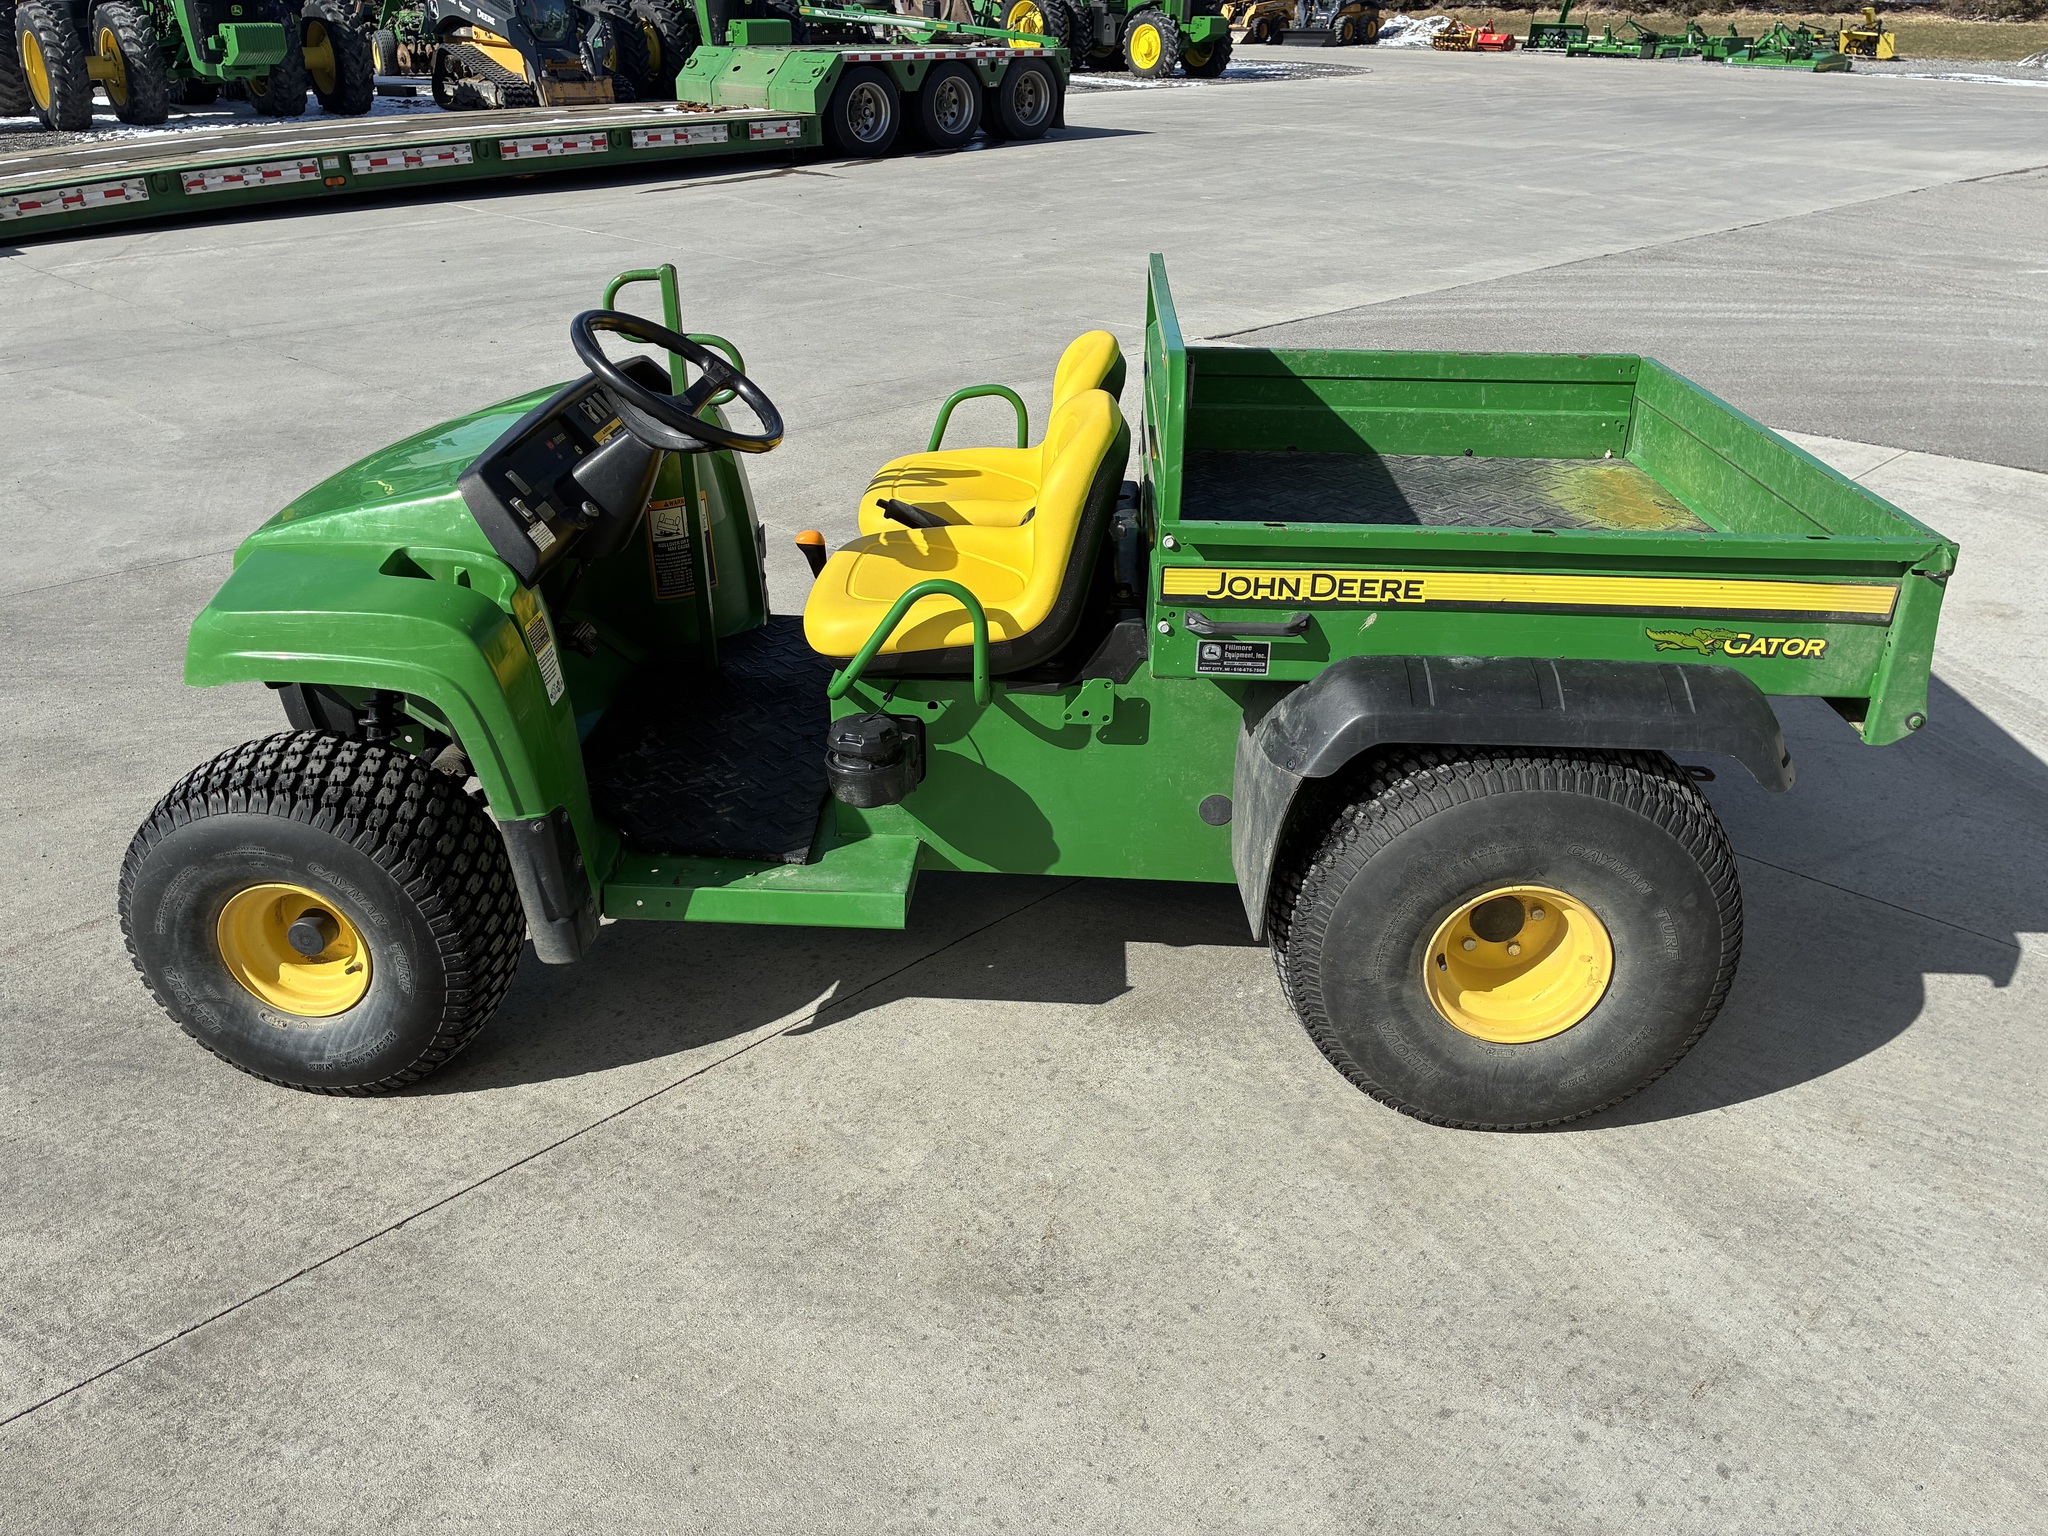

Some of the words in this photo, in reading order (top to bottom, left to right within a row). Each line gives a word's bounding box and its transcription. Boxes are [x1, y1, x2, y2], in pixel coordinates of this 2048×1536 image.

[476, 8, 496, 26] DEERE
[1207, 572, 1301, 597] JOHN
[1310, 573, 1425, 600] DEERE
[1723, 632, 1828, 659] GATOR
[308, 861, 389, 929] CAYMAN
[390, 943, 415, 996] TURF
[1566, 842, 1654, 897] CAYMAN
[1655, 907, 1682, 962] TURF
[161, 965, 222, 1034] INNOVA
[1378, 1020, 1441, 1081] INNOVA
